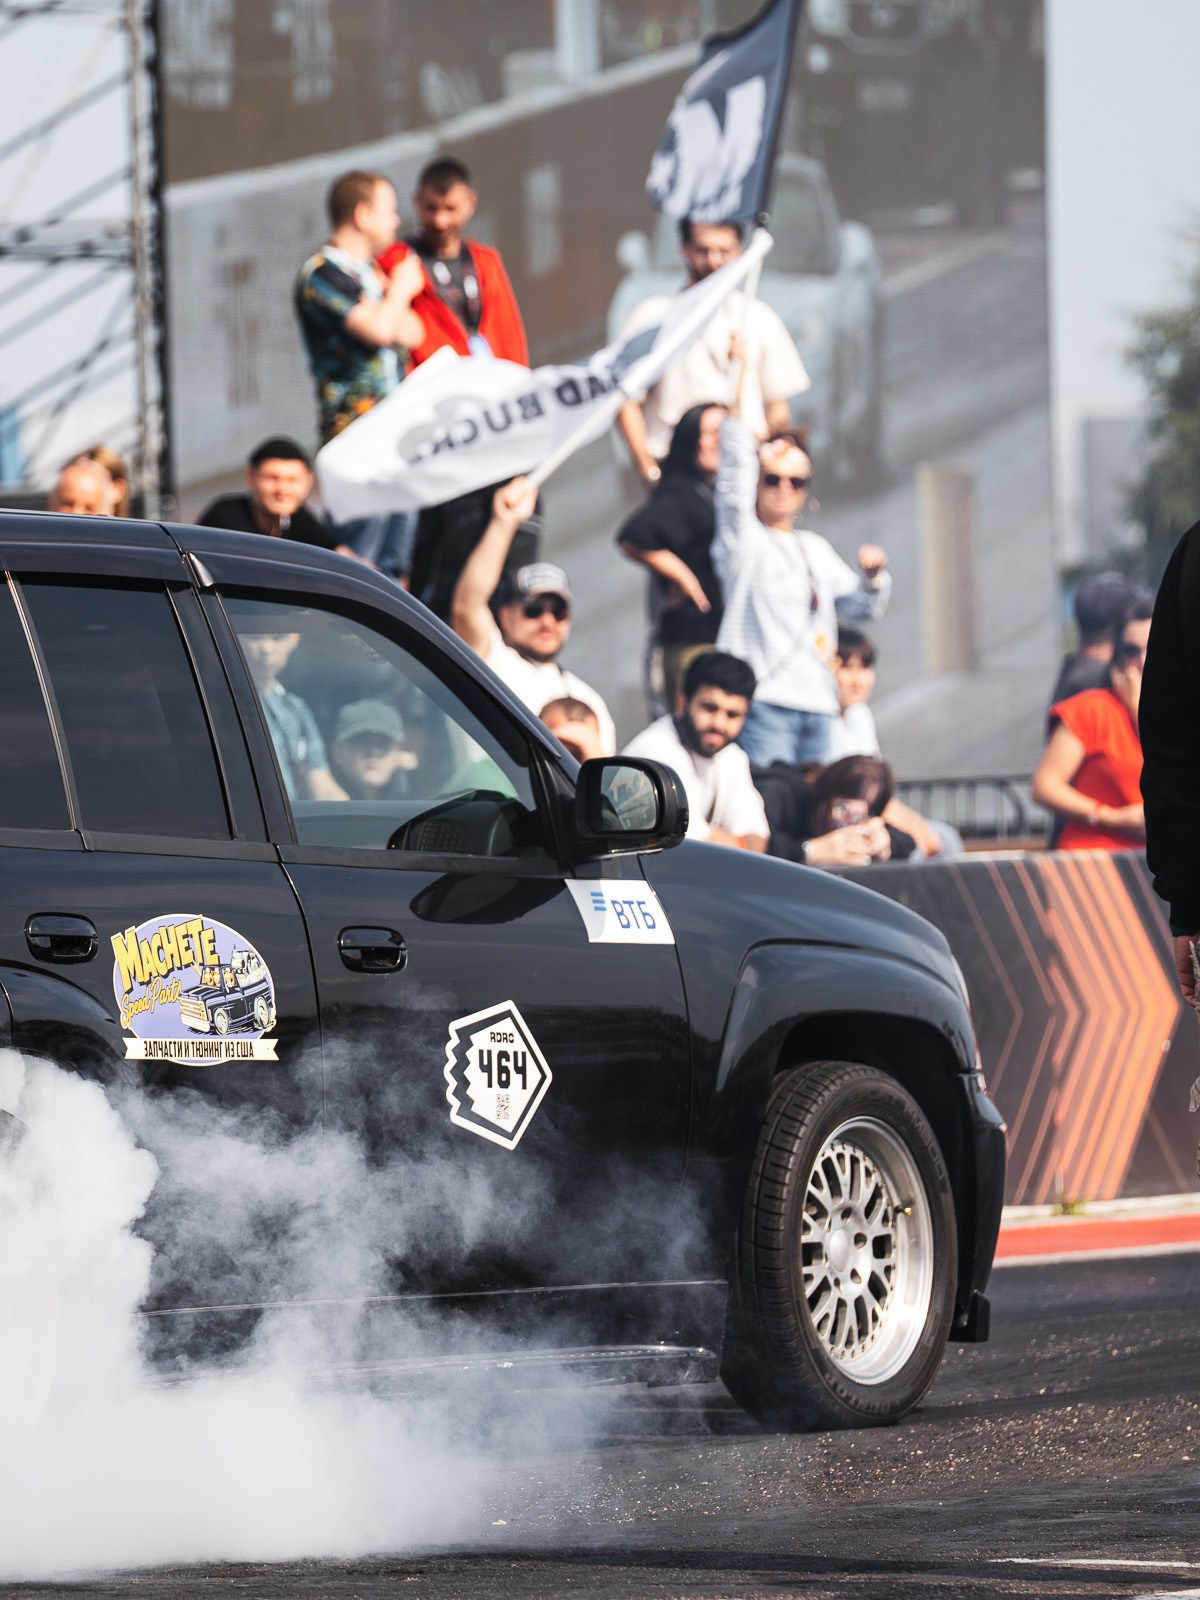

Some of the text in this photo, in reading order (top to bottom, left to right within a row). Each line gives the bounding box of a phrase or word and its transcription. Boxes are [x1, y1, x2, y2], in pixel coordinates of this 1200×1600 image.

[610, 900, 657, 930] ВТБ
[111, 917, 221, 995] MACHETE
[120, 976, 182, 1027] Speed Parts
[143, 1040, 255, 1058] ЗАПЧАСТИ И ТЮНИНГ ИЗ США
[489, 1031, 515, 1044] RDRC
[478, 1048, 527, 1090] 464
